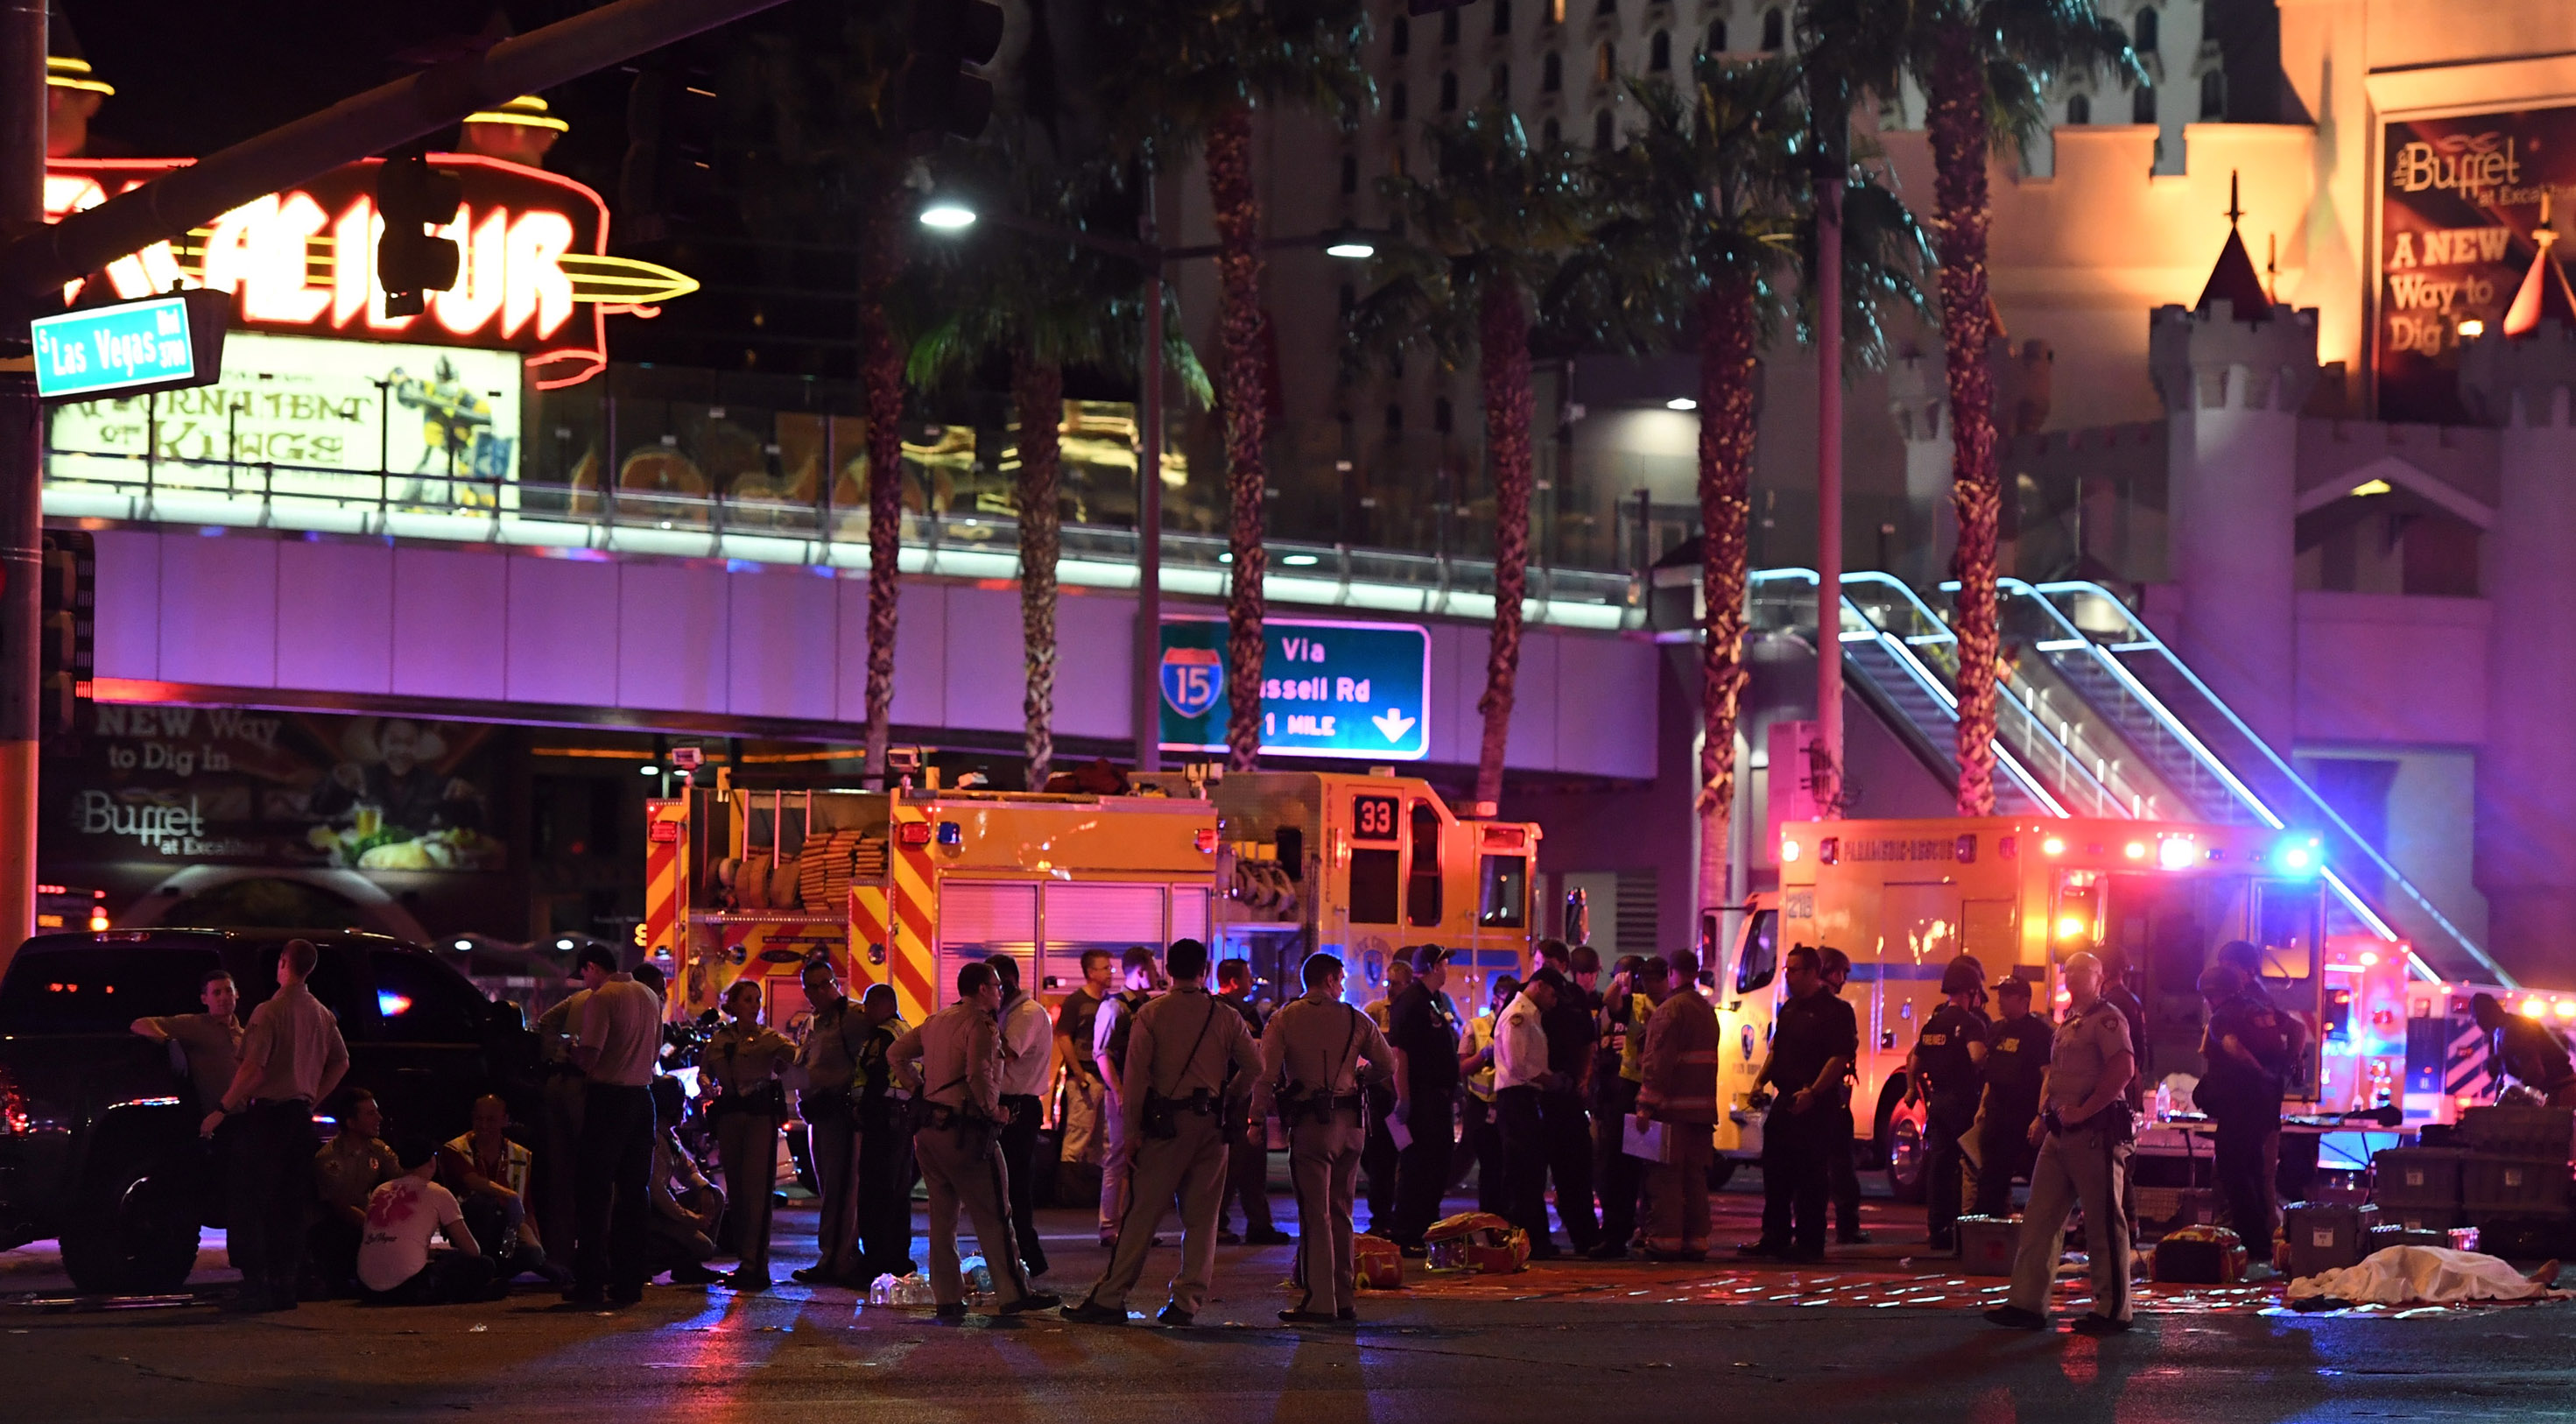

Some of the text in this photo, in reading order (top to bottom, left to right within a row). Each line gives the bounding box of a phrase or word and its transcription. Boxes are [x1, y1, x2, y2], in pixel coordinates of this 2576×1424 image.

[2404, 136, 2521, 200] Buffet
[2390, 226, 2511, 269] A NEW
[2390, 273, 2495, 315] Way to
[39, 328, 50, 354] S
[51, 336, 88, 377] Las
[93, 328, 157, 377] Vegas
[2389, 315, 2443, 356] Dig
[1281, 637, 1325, 663] Via
[1177, 666, 1211, 705] 15
[1259, 676, 1370, 702] ssell Rd
[95, 704, 282, 748] NEW Way
[1265, 712, 1335, 737] 1 MILE
[107, 742, 231, 777] to Dig In
[81, 789, 206, 847] Buffet
[1361, 800, 1390, 833] 33
[160, 837, 179, 855] at
